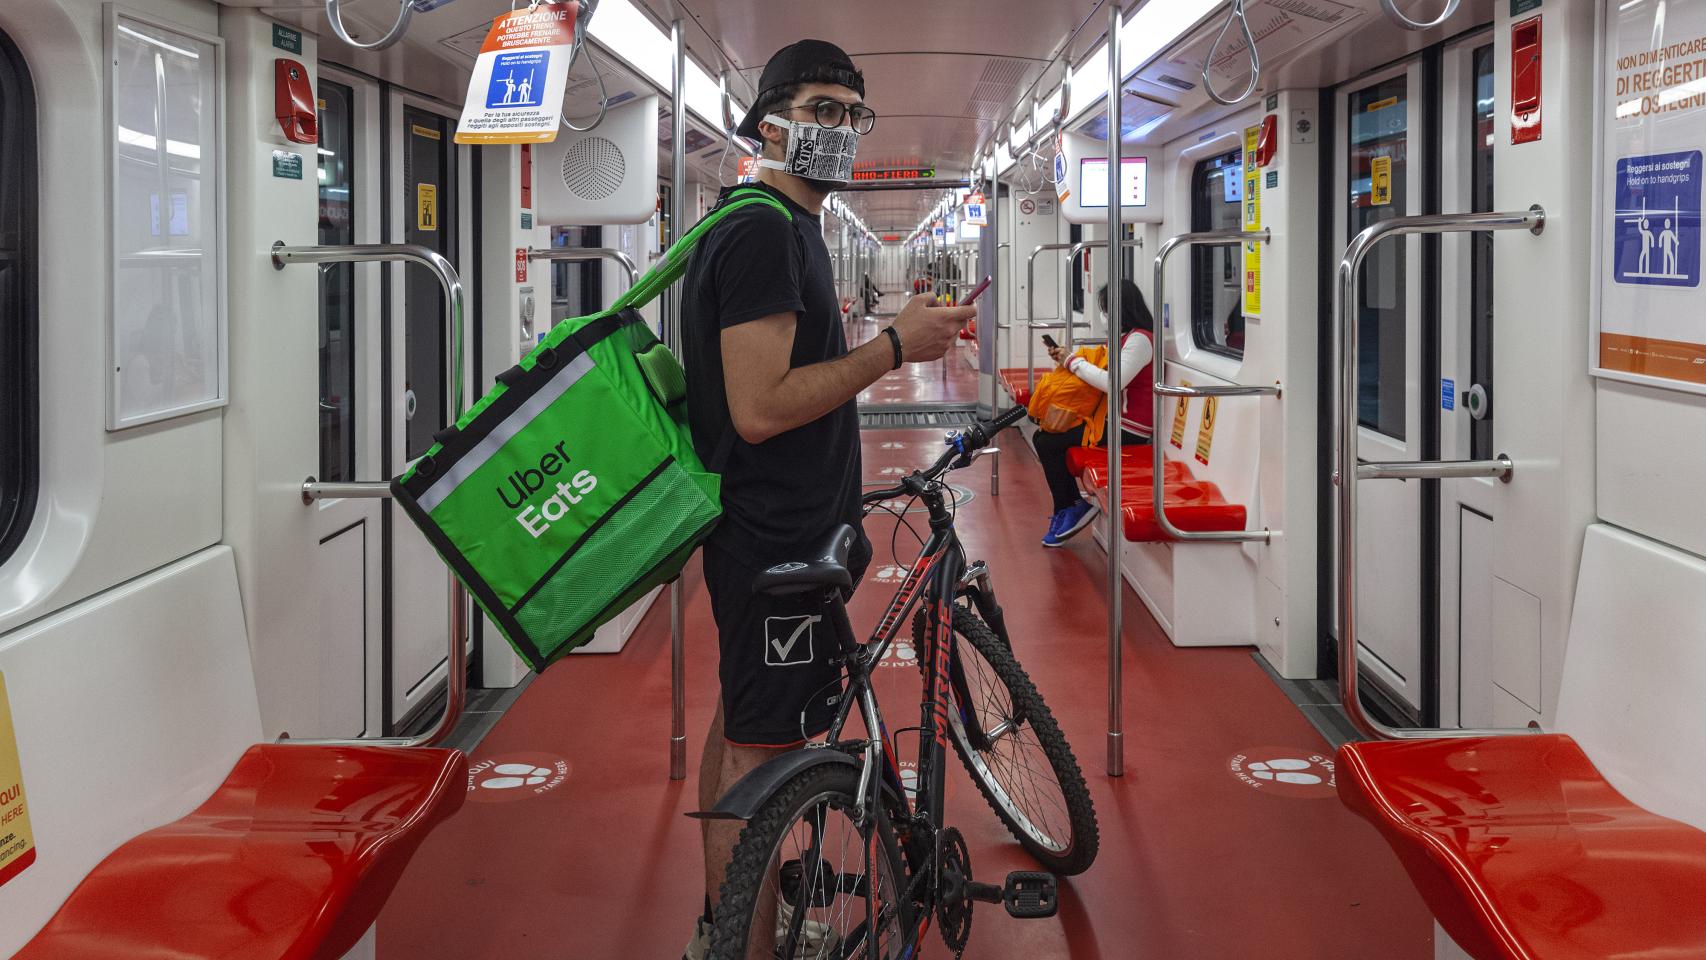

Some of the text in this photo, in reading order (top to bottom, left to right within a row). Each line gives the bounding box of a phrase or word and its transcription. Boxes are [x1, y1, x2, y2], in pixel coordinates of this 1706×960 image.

[498, 10, 567, 29] ATTENZIONE
[506, 22, 554, 34] QUESTO TRENO
[497, 28, 560, 42] POTREBBE FRENARE
[502, 37, 551, 47] BRUSCAMENTE
[1616, 54, 1637, 71] NON
[1616, 58, 1706, 96] DI REGGERTI
[520, 115, 553, 123] passeggeri
[794, 140, 813, 175] Stars
[1626, 159, 1690, 175] Reggersi ai sostegni
[1626, 175, 1641, 186] Hold
[1650, 176, 1656, 184] to
[1658, 174, 1689, 184] handgrips
[517, 260, 526, 272] SOS
[496, 440, 571, 508] Uber
[516, 469, 598, 538] Eats
[933, 598, 951, 749] MIRAGE
[468, 760, 496, 775] QUI
[1230, 754, 1263, 788] STAND HERE
[533, 775, 565, 794] STAND
[0, 783, 20, 806] QUI
[1, 803, 24, 826] HERE
